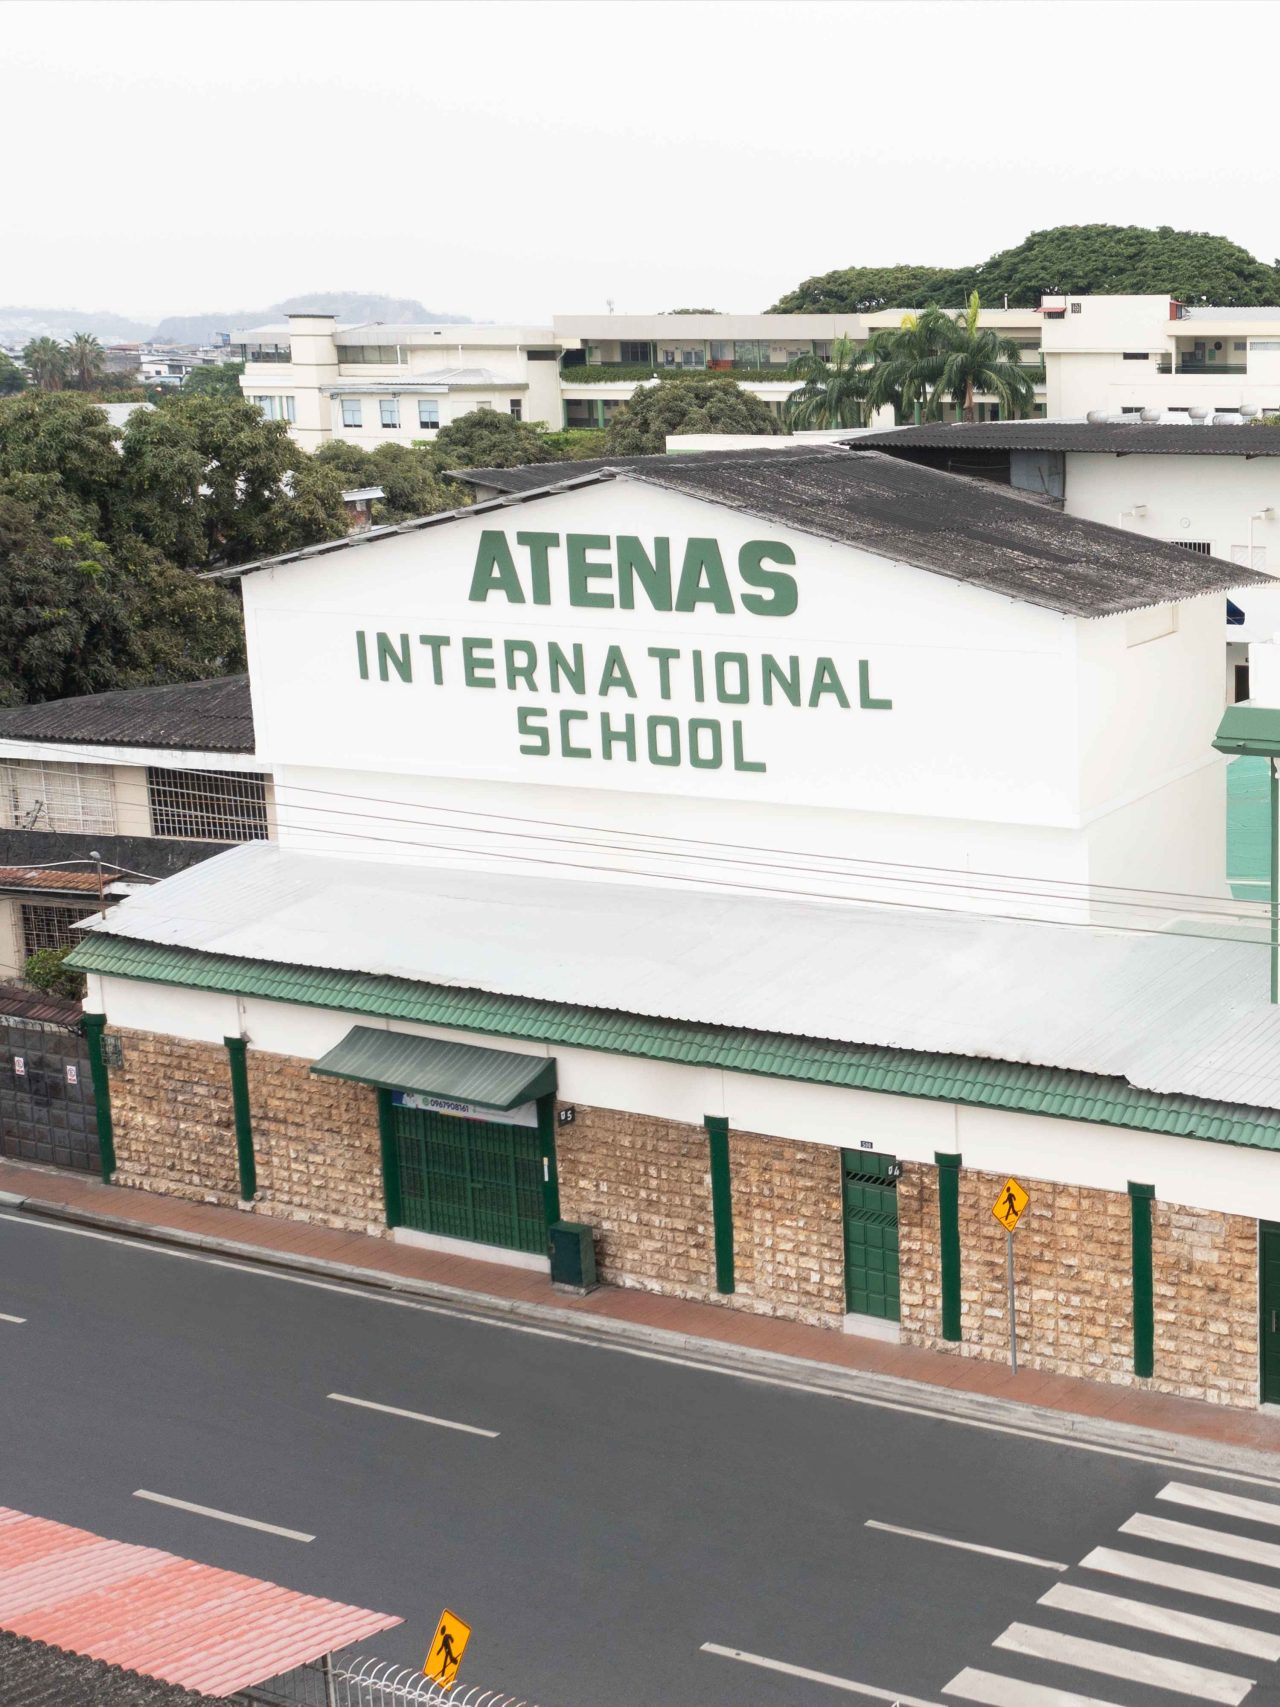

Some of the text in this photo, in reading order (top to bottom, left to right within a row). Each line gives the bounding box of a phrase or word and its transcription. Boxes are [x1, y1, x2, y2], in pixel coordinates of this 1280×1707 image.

[468, 529, 799, 617] ATENAS
[355, 630, 893, 709] INTERNATIONAL
[517, 706, 767, 772] SCHOOL
